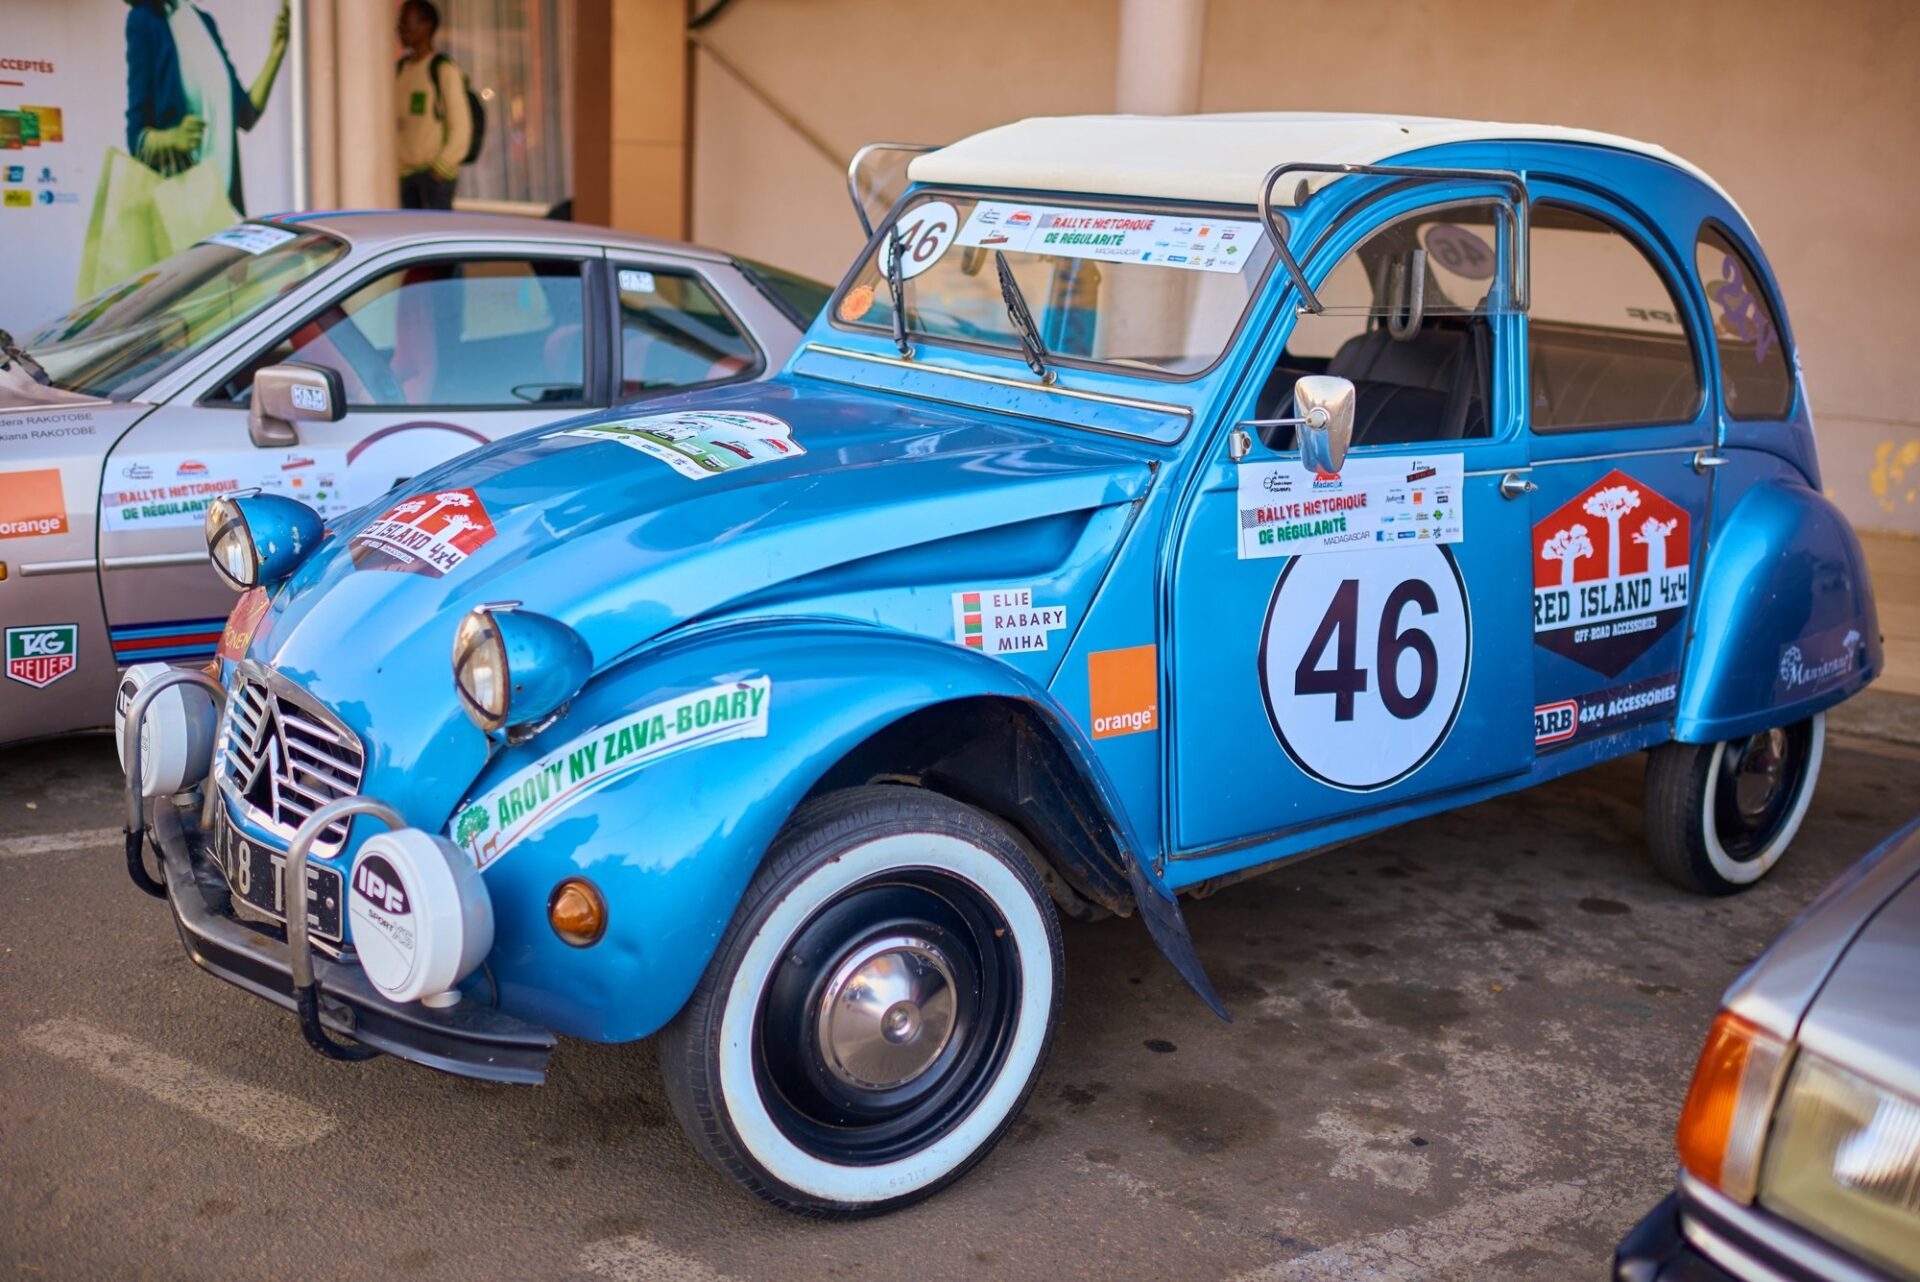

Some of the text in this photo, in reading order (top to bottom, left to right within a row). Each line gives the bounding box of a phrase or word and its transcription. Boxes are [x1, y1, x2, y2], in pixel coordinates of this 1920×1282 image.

[1052, 216, 1091, 230] RALLYE
[1094, 217, 1156, 231] HISTORIQUE
[1044, 232, 1056, 244] DE
[26, 412, 93, 425] RAKOTOBE
[30, 425, 97, 439] RAKOTOBE
[119, 479, 238, 505] RALLYE HISTORIQUE
[121, 506, 139, 521] DE
[1257, 502, 1299, 523] RALLYE
[1304, 493, 1367, 515] HISTORIQUE
[0, 518, 61, 534] orange
[376, 522, 432, 550] ISLAND
[1258, 512, 1347, 545] DE RÉGULARITÉ
[1323, 530, 1370, 546] MADAGASCAR
[993, 592, 1029, 608] ELIE
[1535, 590, 1570, 625] RED
[1580, 578, 1652, 619] ISLAND
[995, 610, 1063, 629] RABARY
[1574, 616, 1657, 644] OFF-ROAD ACCESSORIES
[19, 631, 65, 656] TAG
[998, 634, 1044, 651] MIHA
[1294, 578, 1439, 722] 46
[13, 656, 70, 682] HEUER
[1094, 709, 1152, 732] orange
[1535, 708, 1573, 736] ARB
[1607, 684, 1676, 718] ACCESSORIES
[497, 687, 765, 831] AROVY NY ZAVA-BOARY
[358, 864, 404, 912] IPF
[368, 908, 395, 934] SPORT
